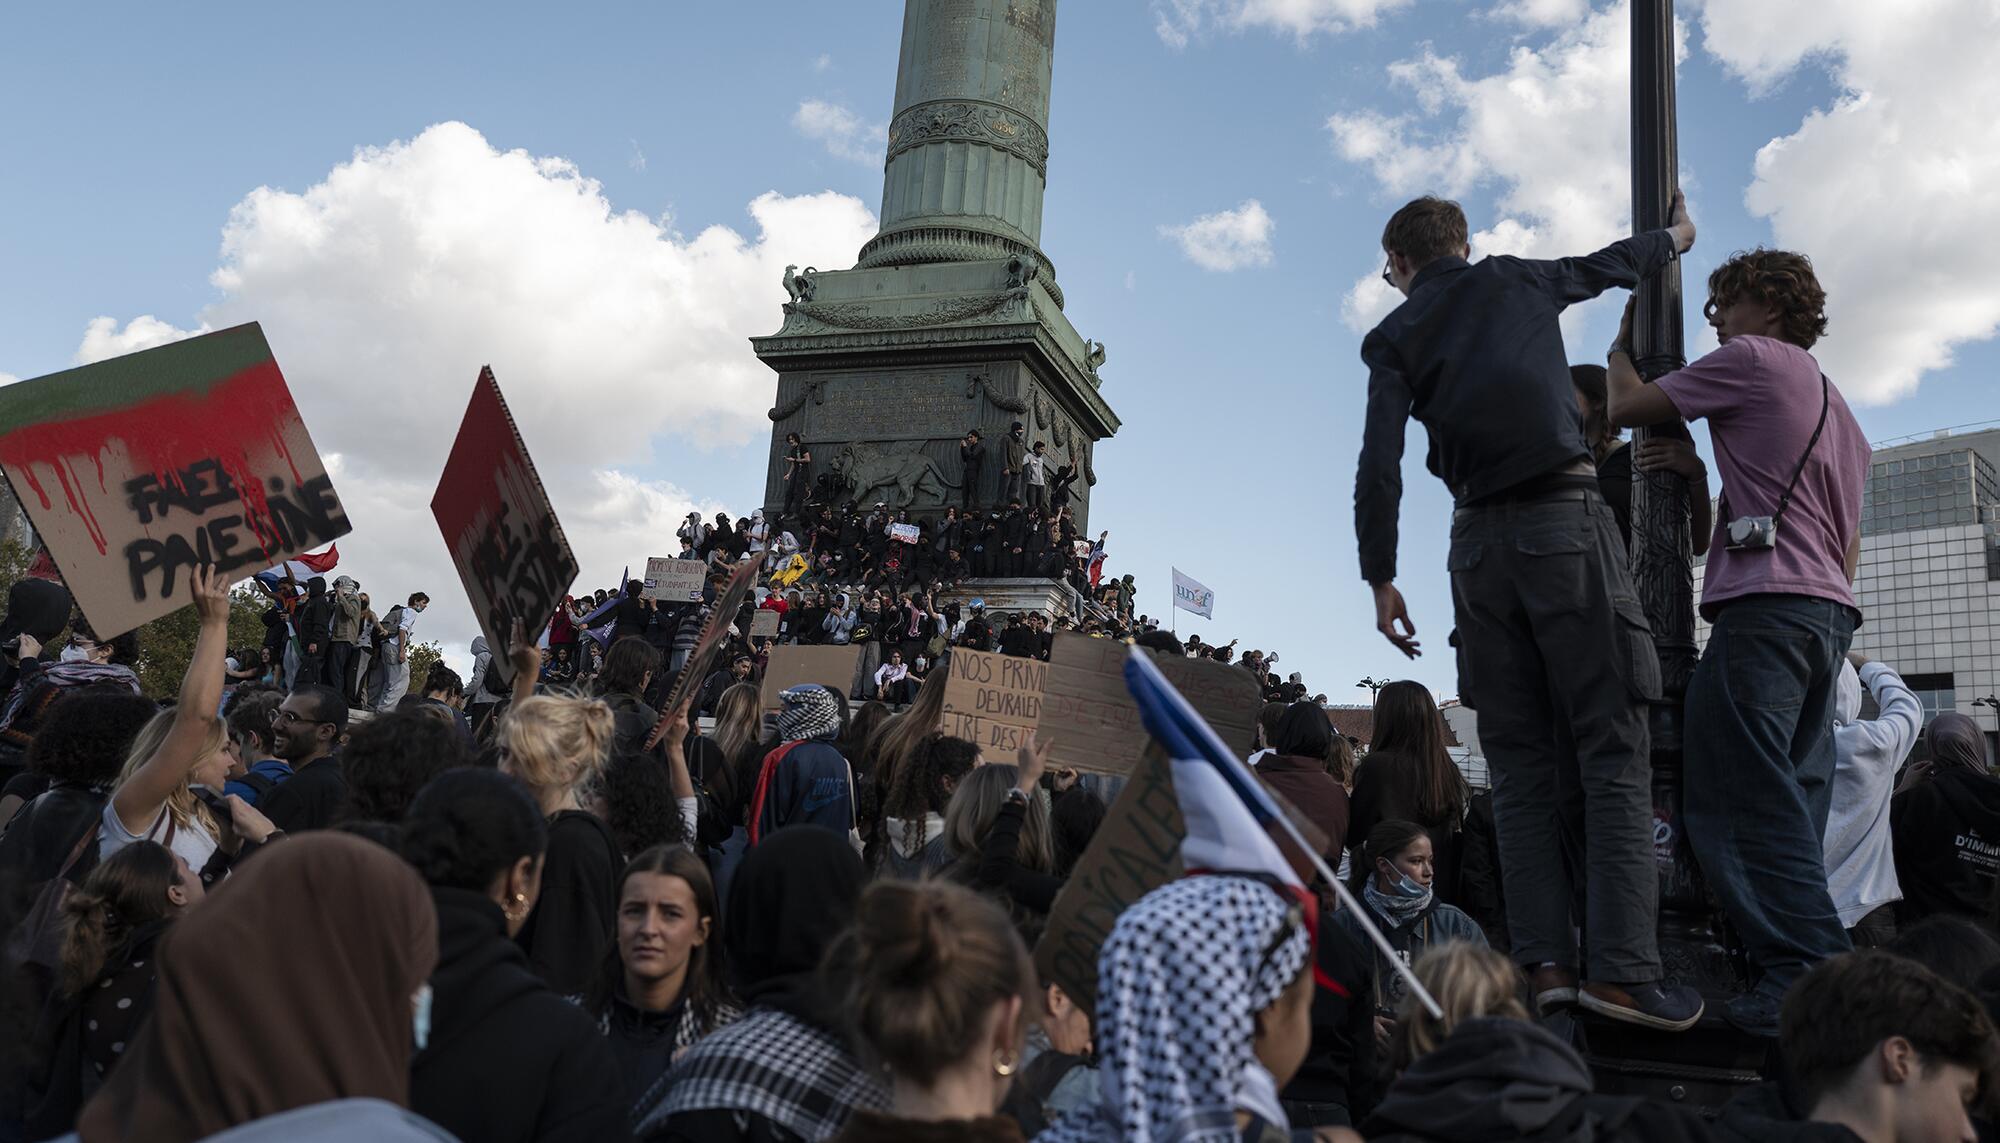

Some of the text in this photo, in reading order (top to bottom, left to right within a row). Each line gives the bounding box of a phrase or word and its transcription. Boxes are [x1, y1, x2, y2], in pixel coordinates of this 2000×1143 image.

[952, 651, 992, 683] NOS
[991, 725, 1018, 752] DES
[812, 776, 847, 796] NIKE
[1955, 834, 2000, 857] D'IMMI
